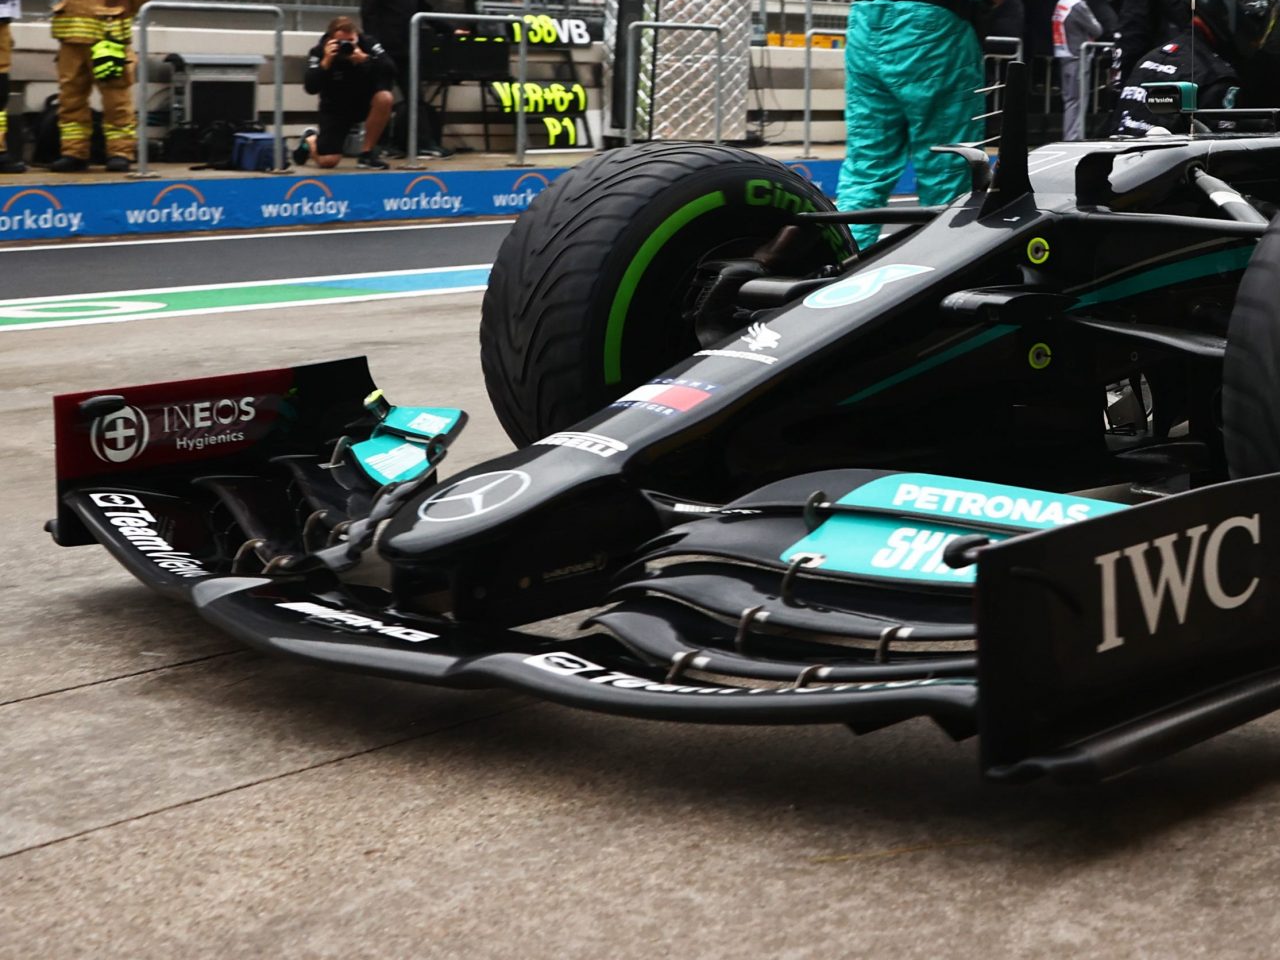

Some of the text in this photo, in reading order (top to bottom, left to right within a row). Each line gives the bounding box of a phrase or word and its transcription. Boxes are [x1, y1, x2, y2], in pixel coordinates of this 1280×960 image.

[261, 197, 348, 218] workday
[384, 192, 462, 212] workday
[493, 188, 537, 207] work
[0, 209, 82, 232] orkday
[126, 202, 223, 225] workday
[163, 395, 256, 433] INEOS
[176, 430, 245, 452] Hygienics
[892, 484, 1091, 525] PETRONAS
[1093, 512, 1261, 653] IWC
